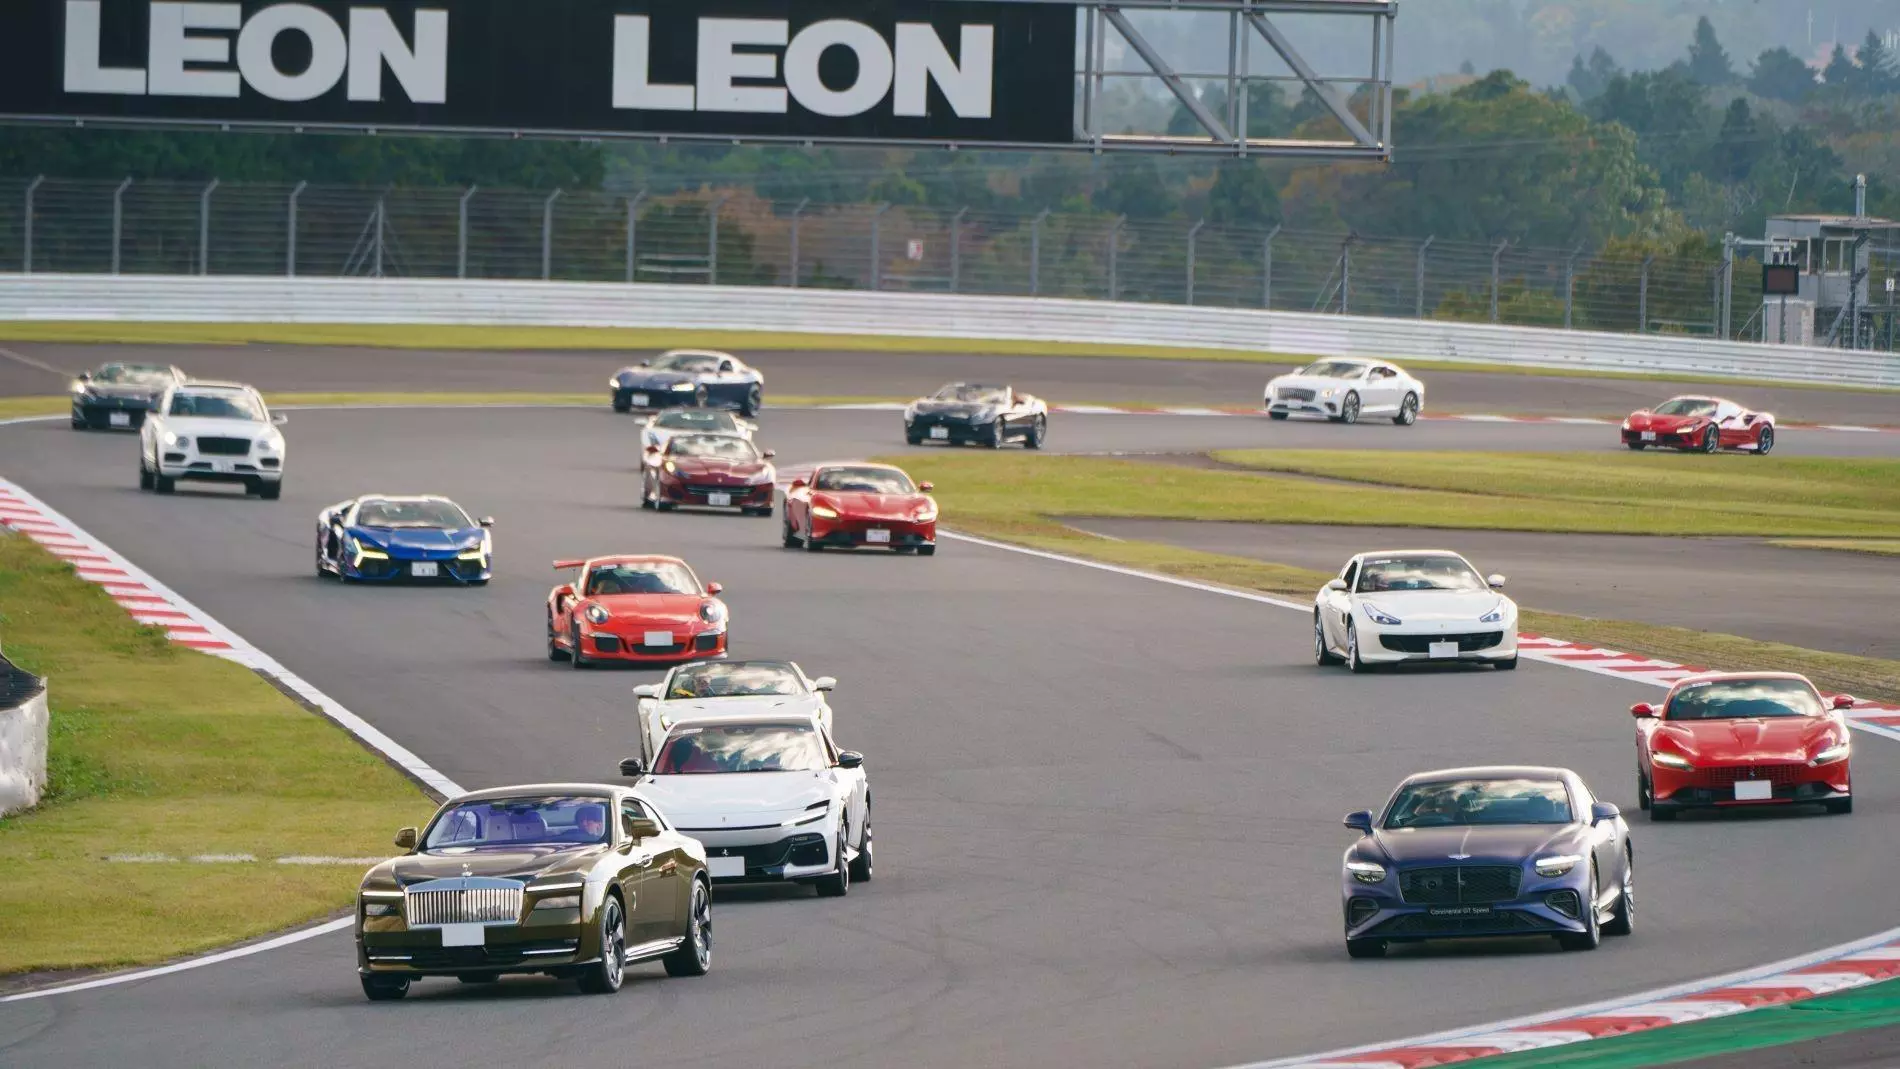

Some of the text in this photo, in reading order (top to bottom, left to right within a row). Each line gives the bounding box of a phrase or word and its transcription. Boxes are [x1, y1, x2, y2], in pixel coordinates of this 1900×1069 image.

[63, 0, 449, 104] LEON
[612, 14, 994, 119] LEON
[1472, 907, 1490, 915] Speed
